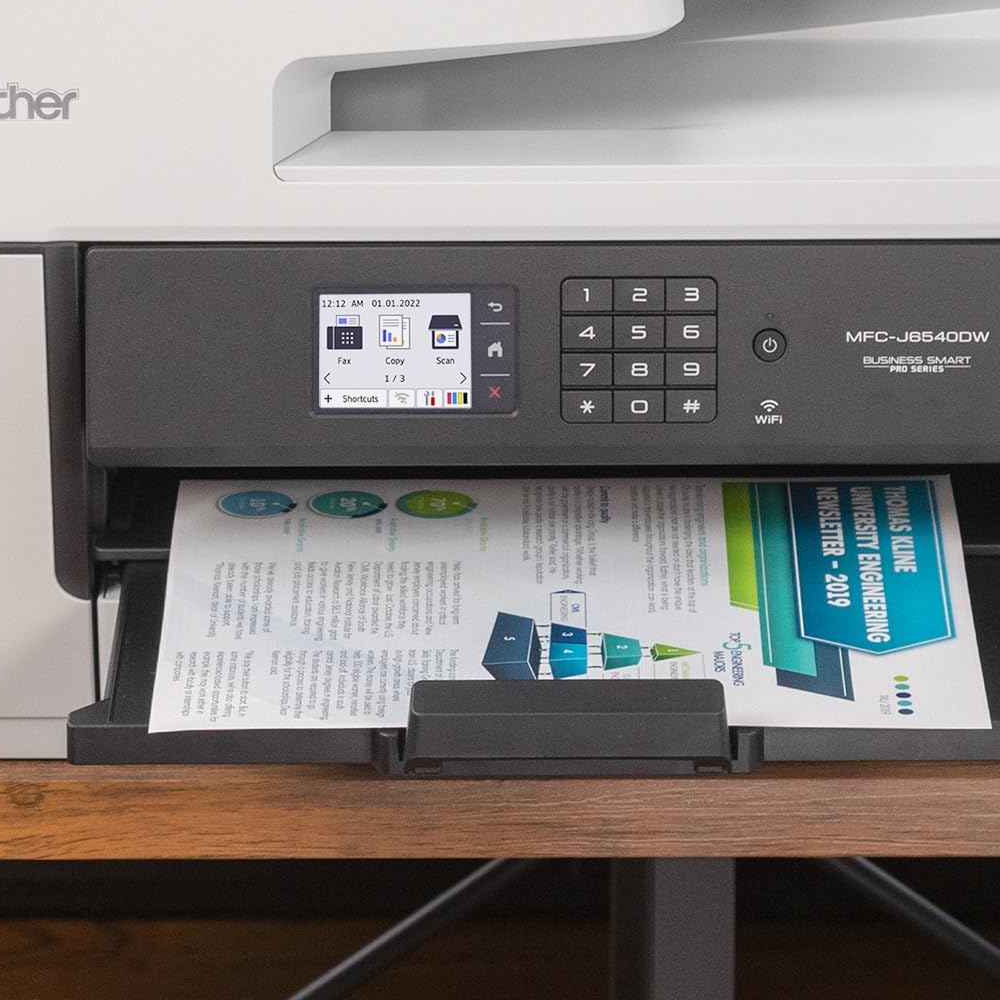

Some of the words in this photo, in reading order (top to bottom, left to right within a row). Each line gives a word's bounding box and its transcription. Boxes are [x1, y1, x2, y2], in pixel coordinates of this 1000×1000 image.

[583, 288, 590, 302] 1
[632, 288, 648, 302] 2
[684, 288, 700, 302] 3
[322, 300, 346, 308] 12:12
[351, 300, 364, 308] AM
[371, 299, 421, 308] 01.01.2022
[578, 326, 596, 340] 4
[631, 326, 647, 340] 5
[683, 326, 700, 340] 6
[846, 331, 990, 343] MFC-J6540DW
[337, 357, 351, 365] Fax
[385, 357, 405, 367] Copy
[436, 357, 455, 365] Scan
[863, 356, 923, 364] BUSINESS
[927, 356, 972, 364] SMART
[579, 363, 596, 377] 7
[631, 363, 648, 377] 8
[683, 363, 700, 377] 9
[890, 365, 908, 373] PRO
[910, 365, 944, 373] SERIES
[342, 395, 379, 403] Shortcuts
[754, 414, 783, 425] WiFi
[884, 486, 912, 532] THOMAS
[816, 487, 846, 557] NEWSLETTER
[850, 486, 880, 550] UNIVERSITY
[890, 536, 918, 573] KLINE
[824, 574, 851, 608] 2019
[858, 553, 891, 644] ENGINEERING
[722, 642, 752, 650] 5
[714, 651, 726, 673] MAJORS
[730, 650, 744, 687] ENGINEERING
